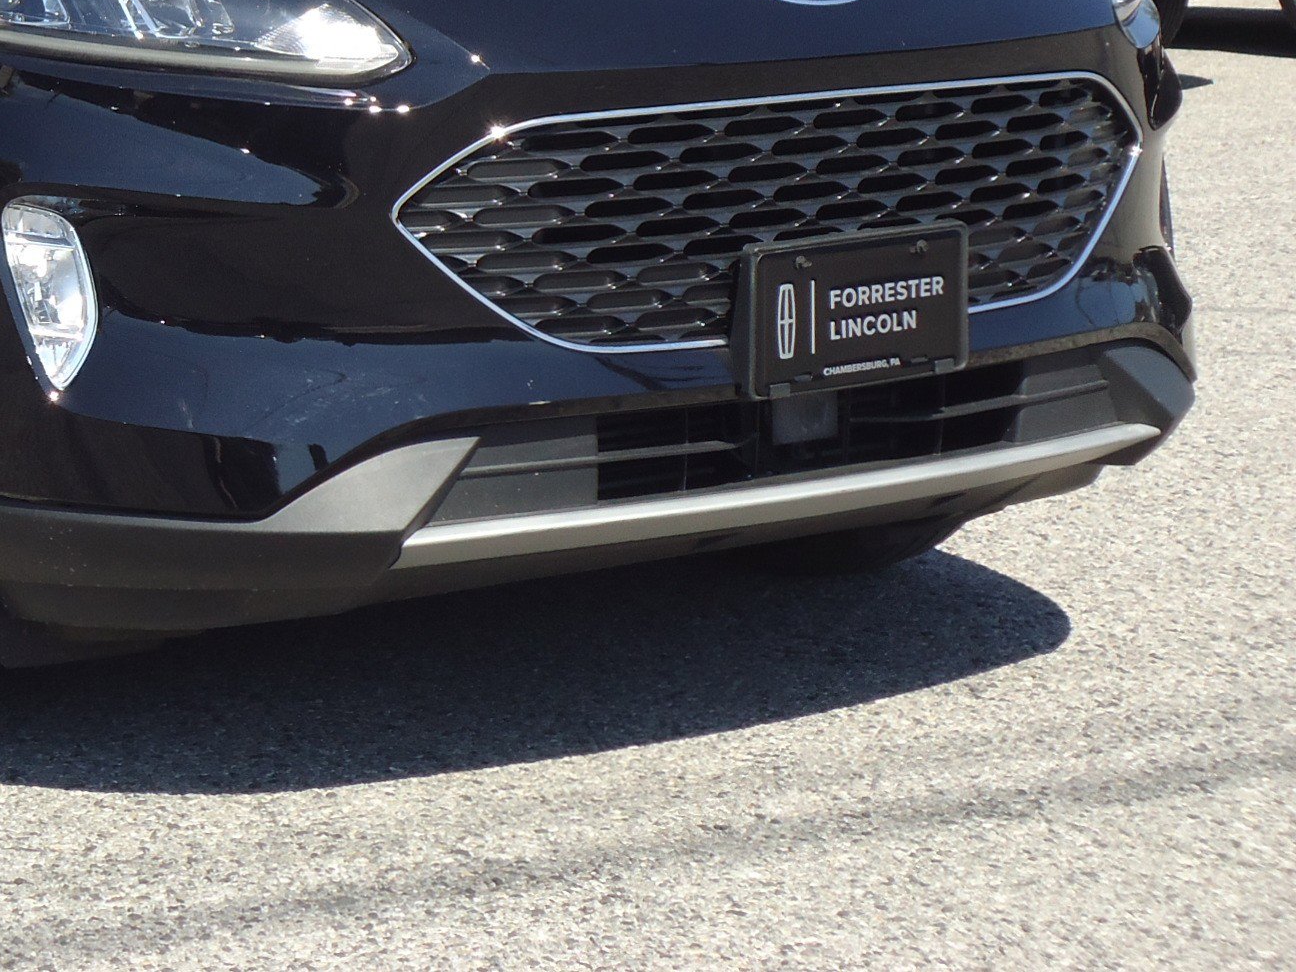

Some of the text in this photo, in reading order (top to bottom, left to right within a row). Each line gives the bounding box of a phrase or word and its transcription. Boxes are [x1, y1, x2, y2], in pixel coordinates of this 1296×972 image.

[830, 276, 944, 309] FORRESTER
[830, 310, 917, 341] LINCOLN
[823, 357, 901, 376] CHAMBERSBURG, PA
